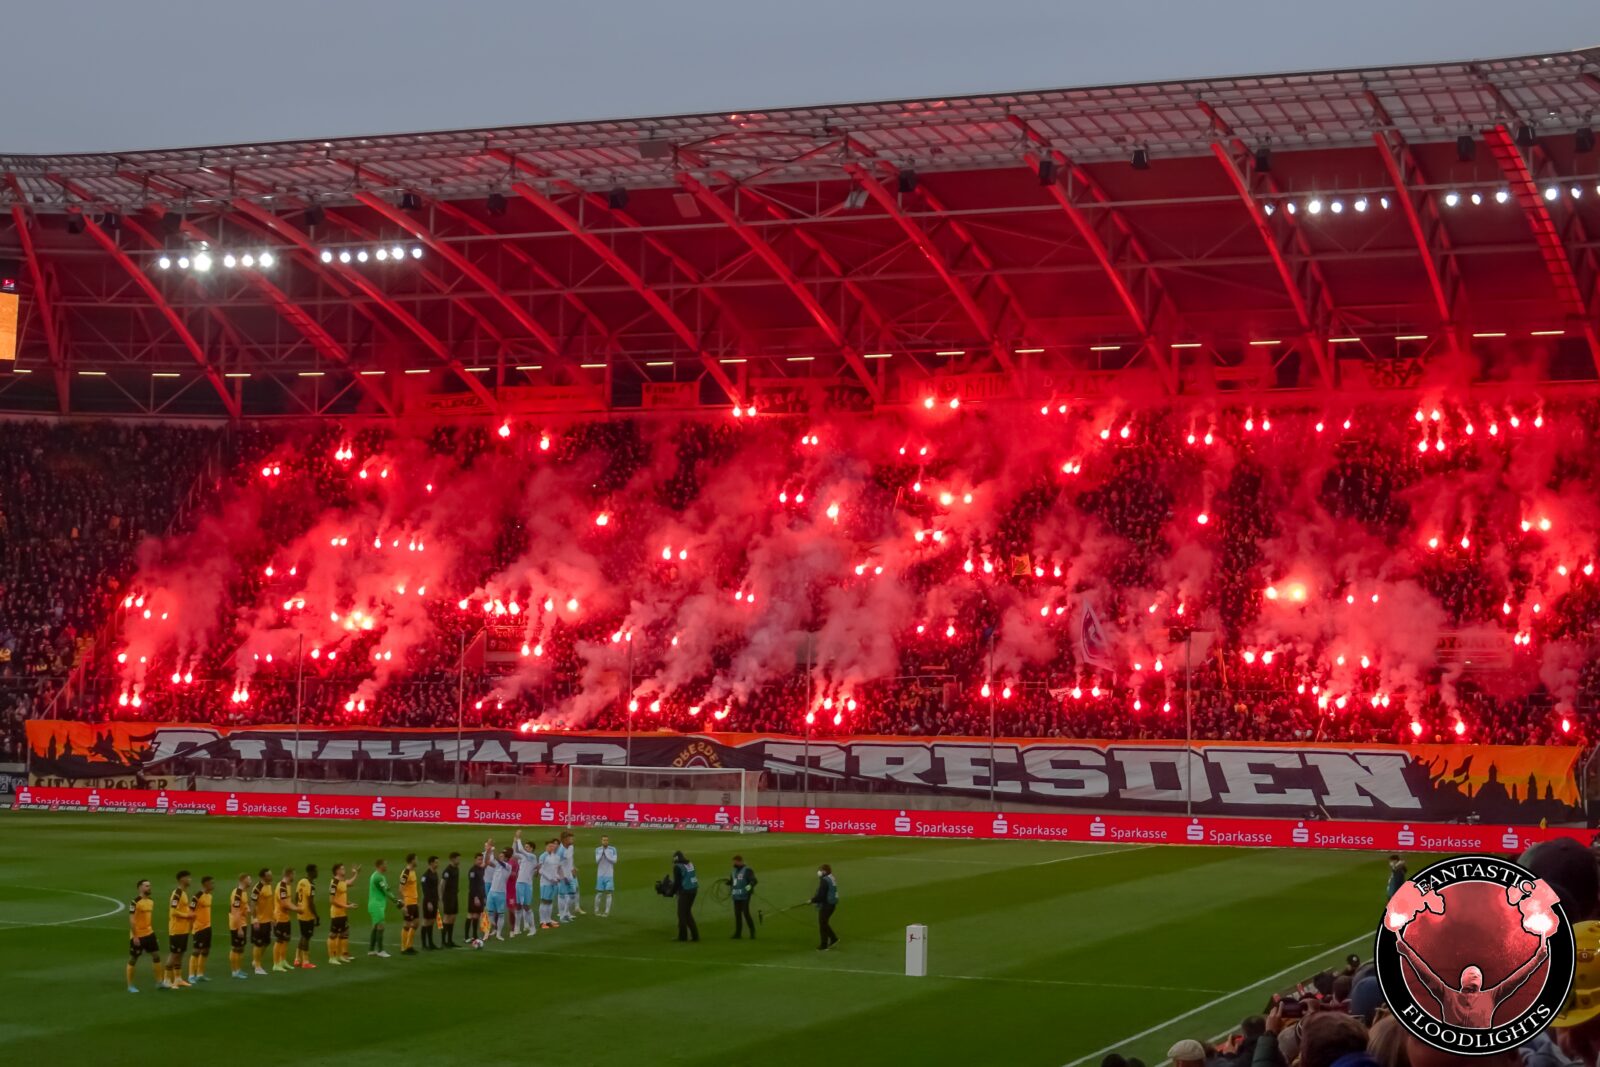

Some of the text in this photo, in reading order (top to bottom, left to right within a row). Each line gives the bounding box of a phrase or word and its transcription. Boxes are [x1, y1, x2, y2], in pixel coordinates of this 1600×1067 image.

[764, 742, 1422, 809] DRESDEN
[103, 778, 169, 790] POER
[242, 803, 288, 814] Sparkasse
[314, 804, 360, 816] Sparkasse
[390, 807, 441, 819] Sparkasse
[474, 809, 522, 821] Sparkasse
[643, 814, 698, 823] Sparkase
[733, 816, 785, 829] Sarkasse
[824, 819, 877, 832] Sparkasse
[915, 821, 974, 835] Sparkasse
[1012, 824, 1068, 837] Sparkasse
[1110, 827, 1168, 839] Sparkasse
[1209, 829, 1273, 843] Sparkasse
[1314, 832, 1374, 845] Sparkasse
[1419, 835, 1482, 848] Sparkasse
